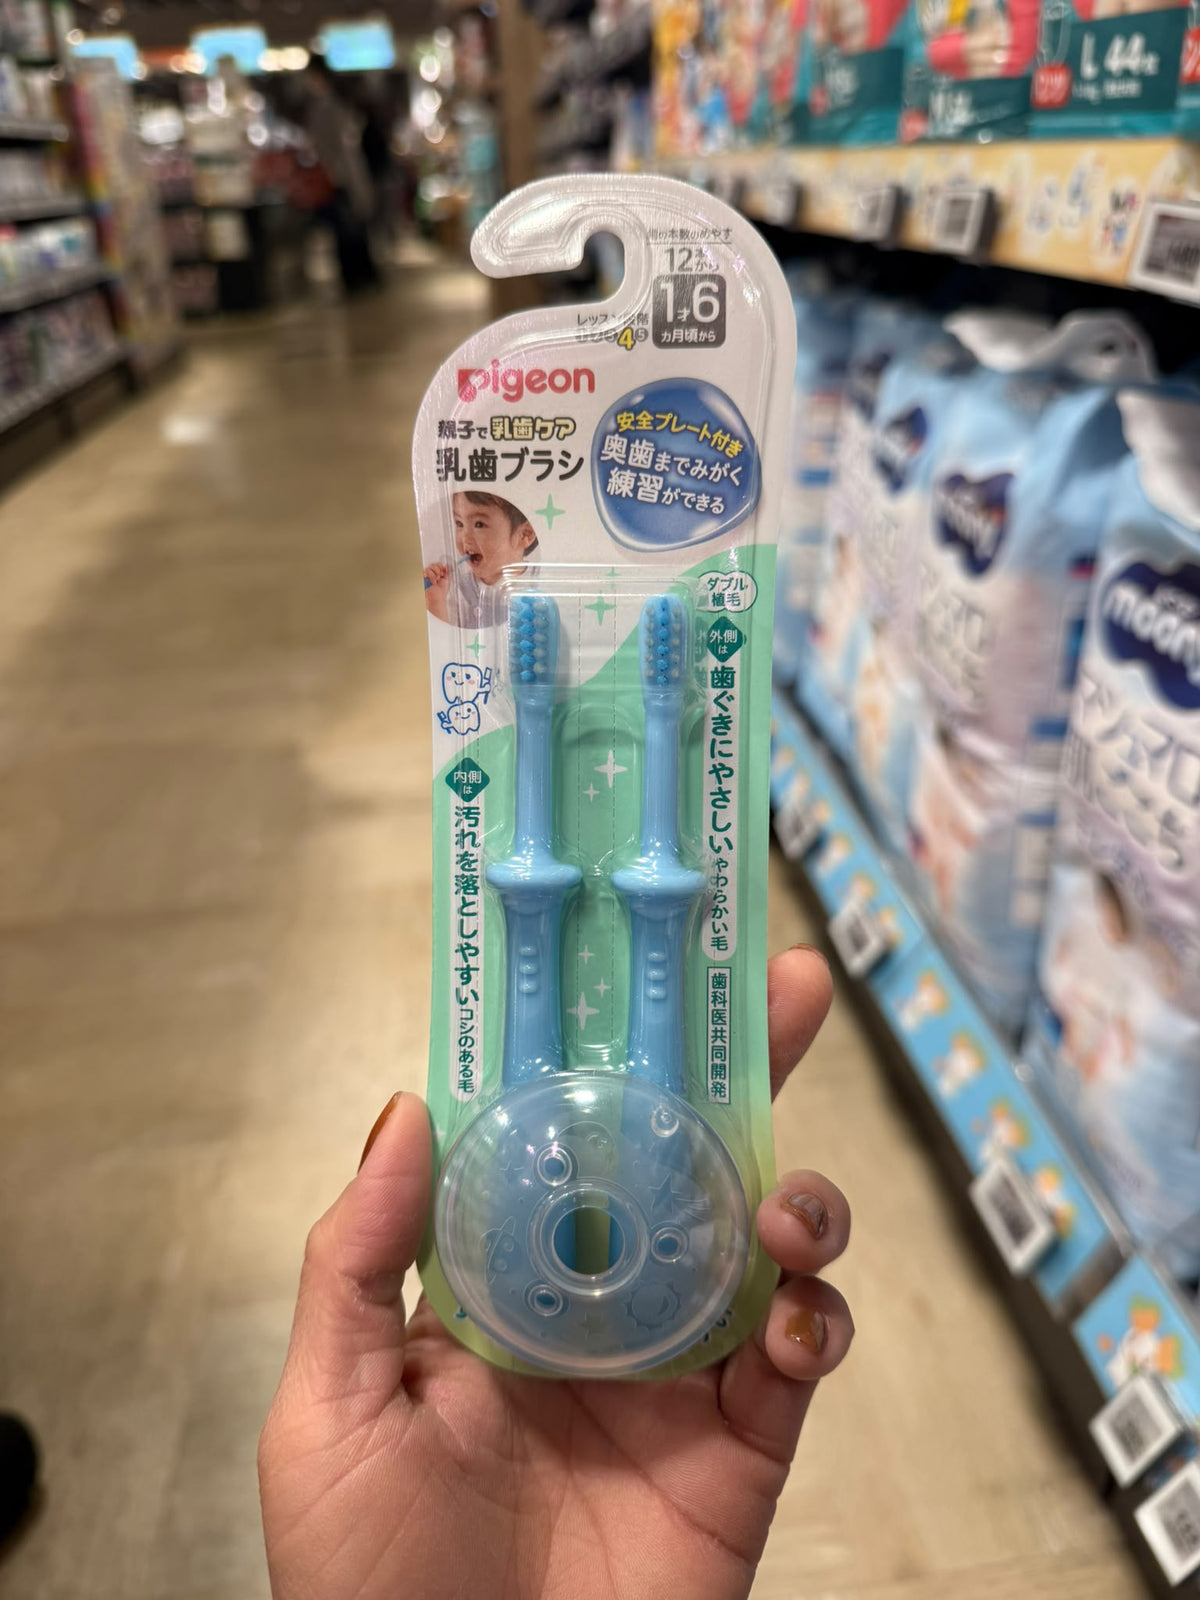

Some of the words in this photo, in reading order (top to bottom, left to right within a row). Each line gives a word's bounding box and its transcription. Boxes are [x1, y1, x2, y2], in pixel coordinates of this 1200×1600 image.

[457, 358, 595, 403] pigeon
[616, 410, 743, 458] 安全プレート付き
[436, 446, 584, 482] 乳歯ブラシ
[600, 433, 743, 487] 奥歯までみがく
[606, 467, 725, 515] 練習ができる
[707, 576, 748, 592] ダブル
[711, 592, 741, 607] 植毛
[711, 972, 728, 1098] 歯科医共同開発
